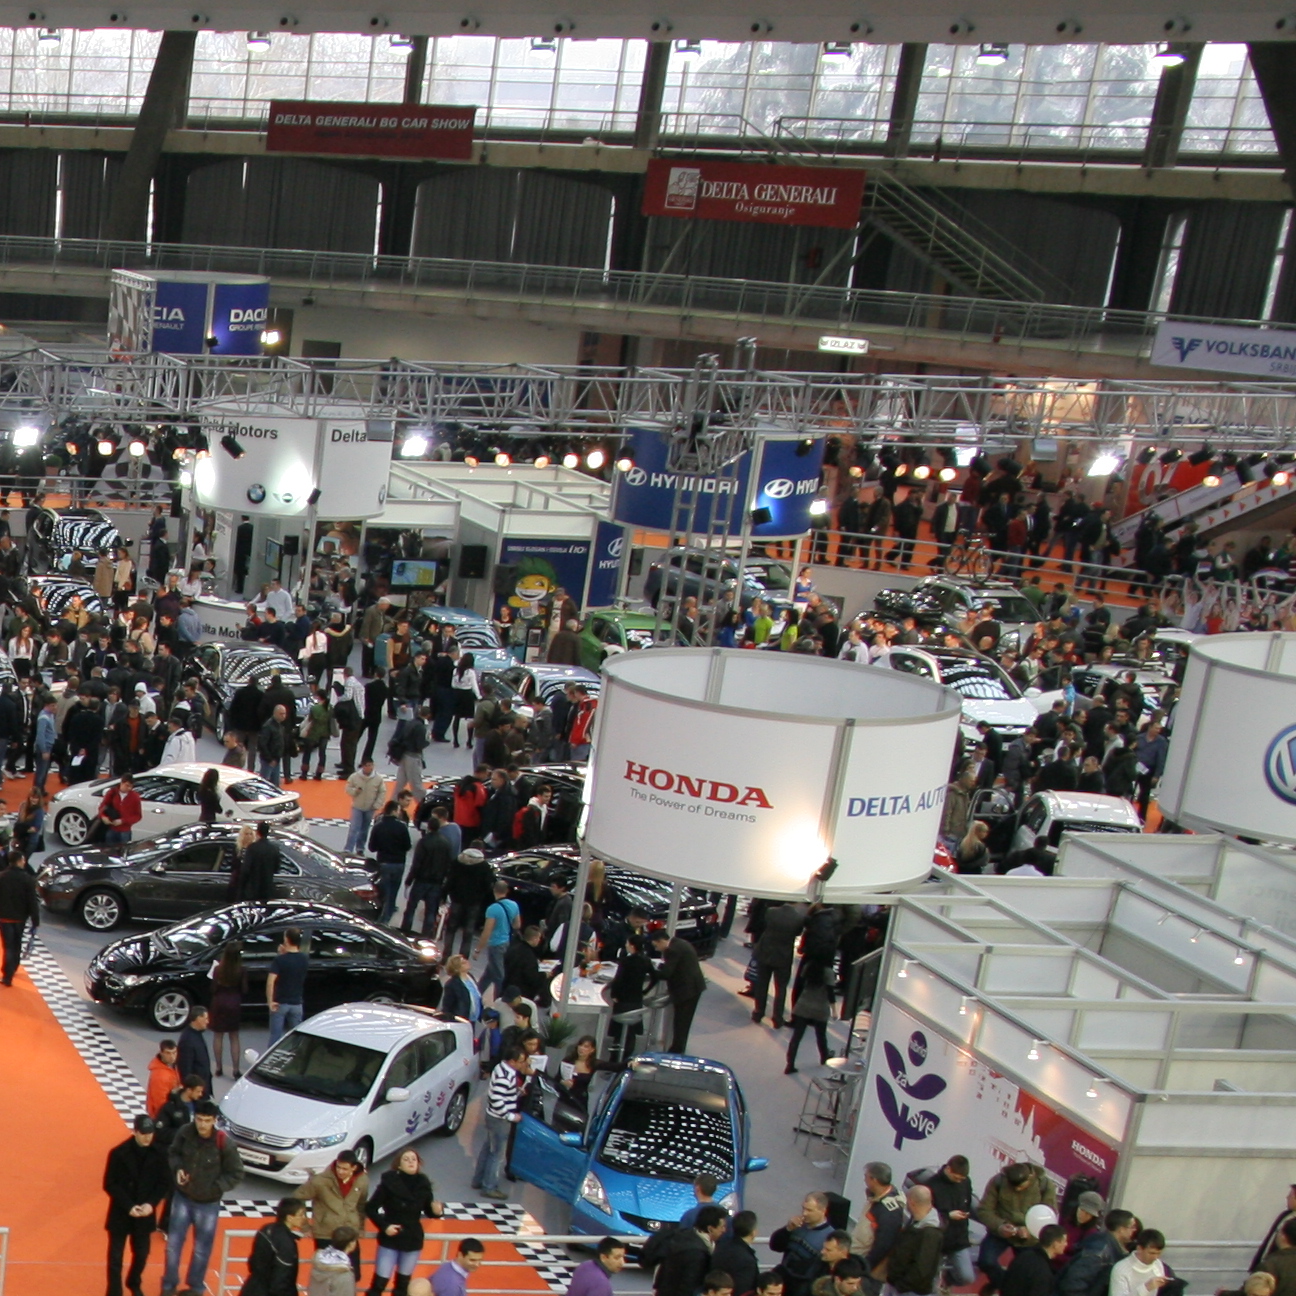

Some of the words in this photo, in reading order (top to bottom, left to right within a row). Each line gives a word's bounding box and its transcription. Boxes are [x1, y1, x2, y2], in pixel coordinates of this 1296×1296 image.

[275, 114, 311, 125] DELTA
[315, 115, 377, 127] GENERALI
[380, 117, 397, 128] BG
[402, 118, 428, 129] CAR
[431, 119, 470, 130] SHOW
[701, 181, 749, 200] DELTA
[754, 184, 837, 205] GENERALI
[735, 202, 795, 218] Osiguranje
[152, 306, 185, 321] CIA
[1206, 339, 1296, 360] VOLKSBAN
[331, 428, 367, 443] Delta
[650, 472, 739, 495] HYUNDAI
[218, 626, 242, 639] Mot
[623, 760, 774, 809] HONDA
[630, 786, 647, 801] The
[649, 793, 686, 812] Power
[687, 803, 701, 814] of
[704, 805, 757, 824] Dreams
[846, 793, 912, 818] DELTA
[1071, 1140, 1107, 1171] HONDA
